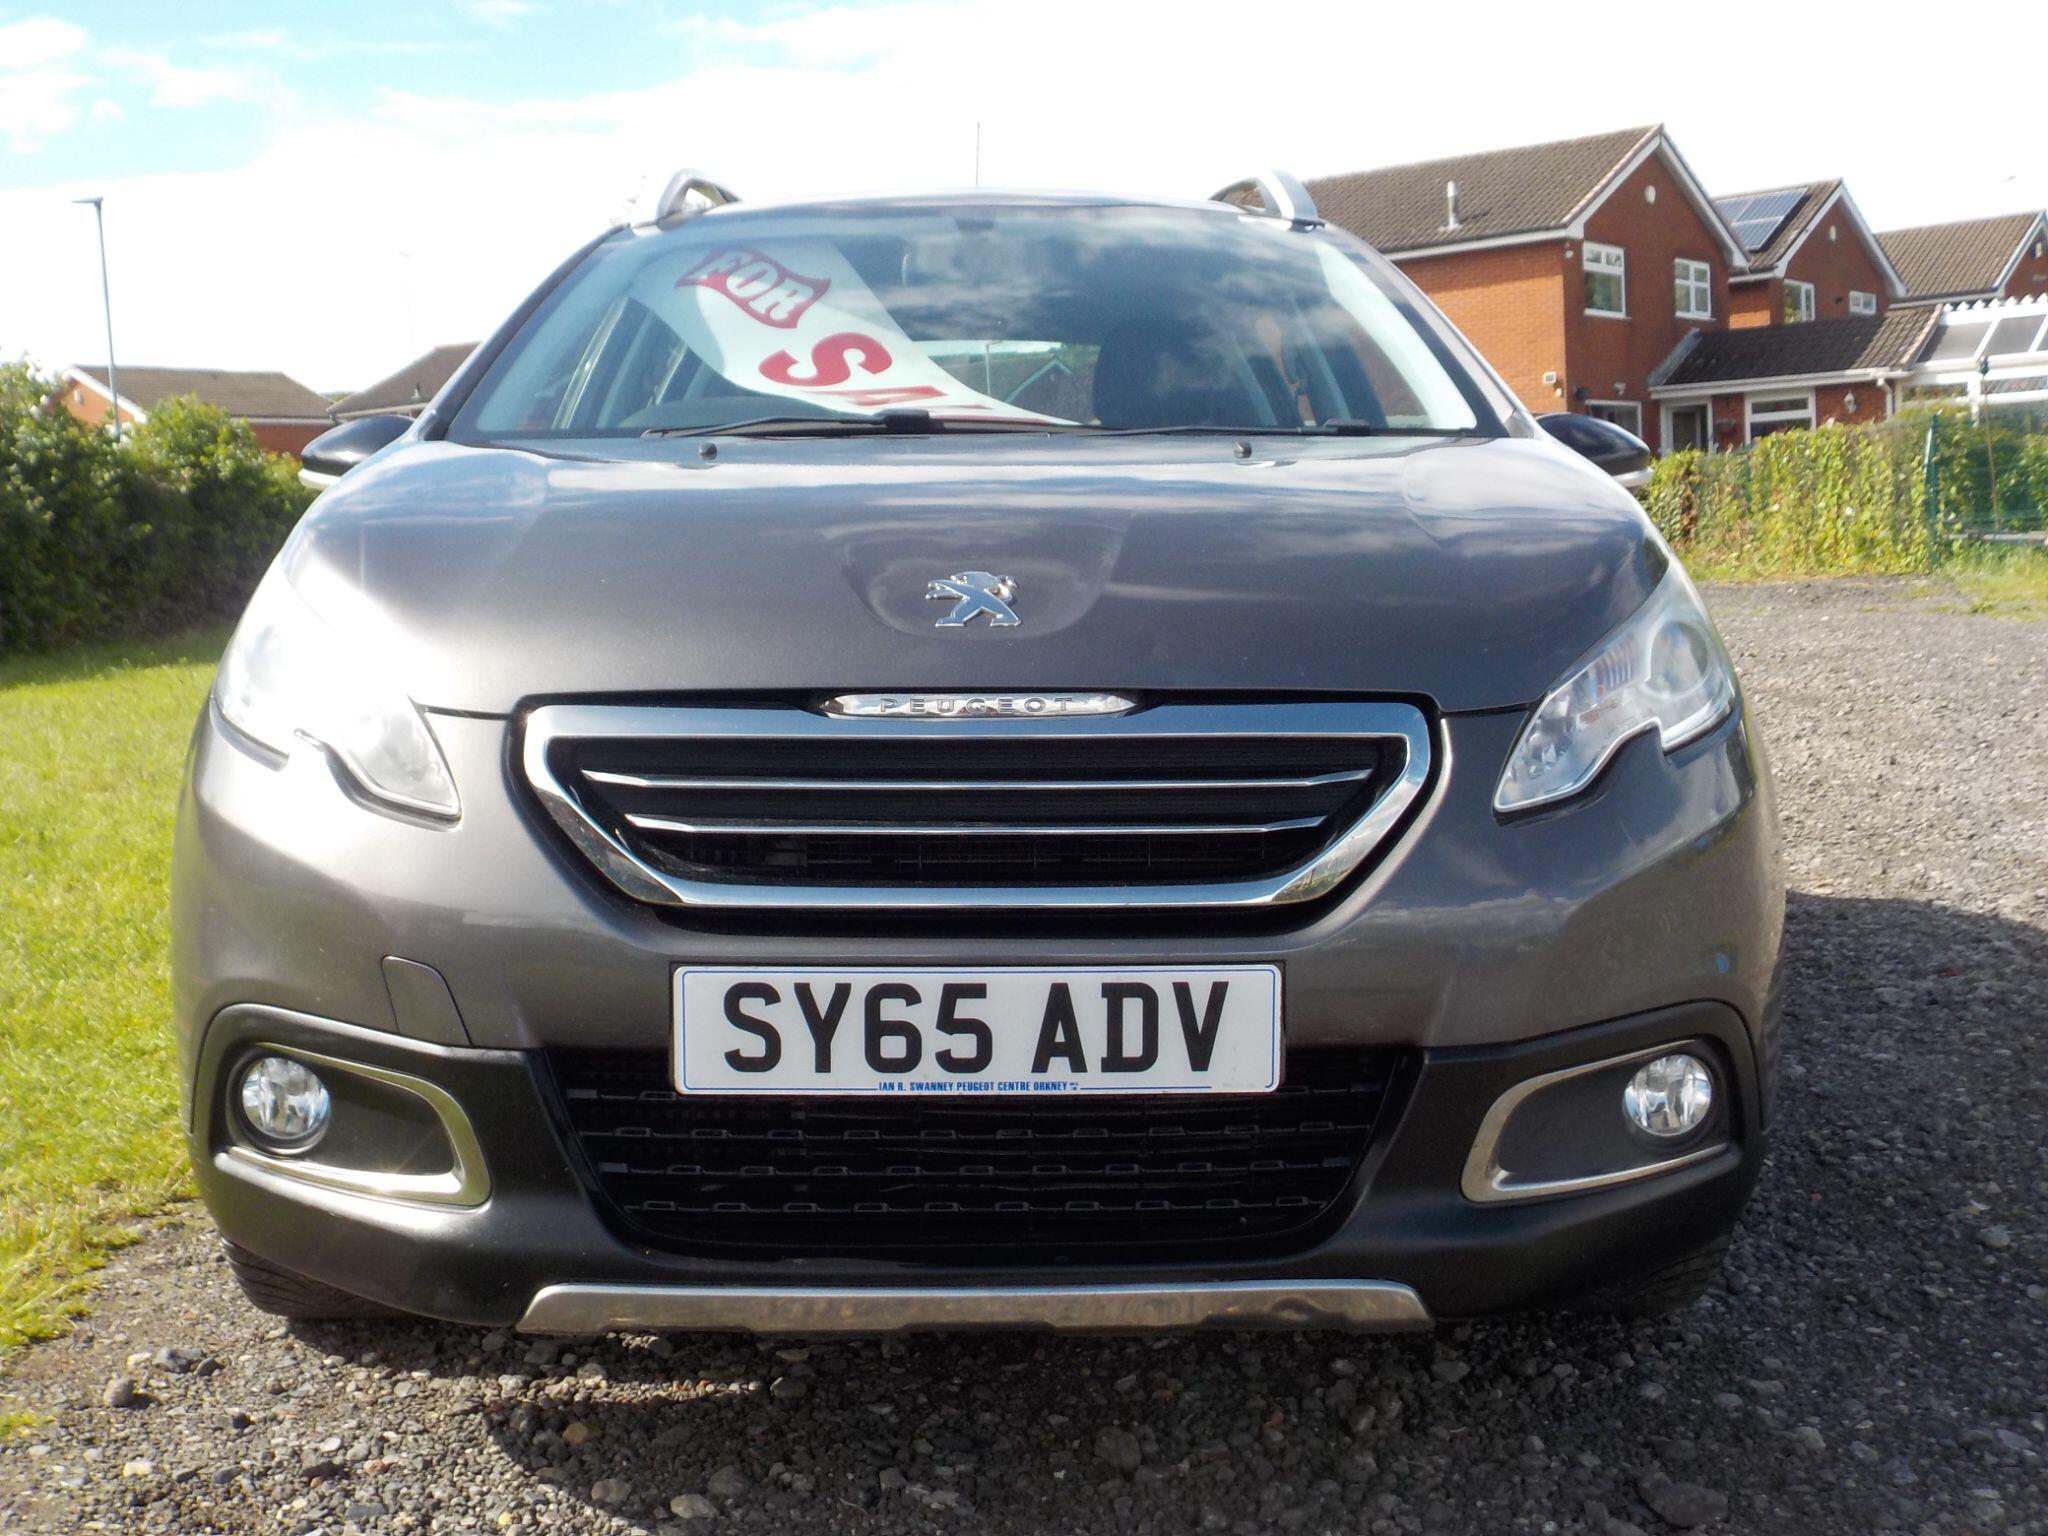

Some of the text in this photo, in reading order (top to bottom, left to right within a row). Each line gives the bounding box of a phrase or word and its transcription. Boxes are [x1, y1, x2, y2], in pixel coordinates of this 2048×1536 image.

[686, 250, 813, 320] FOR
[881, 697, 1073, 714] PEUGEOT
[723, 980, 1230, 1075] SY65 ADV
[878, 1081, 895, 1092] IAN
[909, 1081, 954, 1092] SWANNEY
[956, 1081, 994, 1092] PEUGEOT
[997, 1081, 1031, 1092] CENTRE
[1033, 1081, 1068, 1092] ORKNEY
